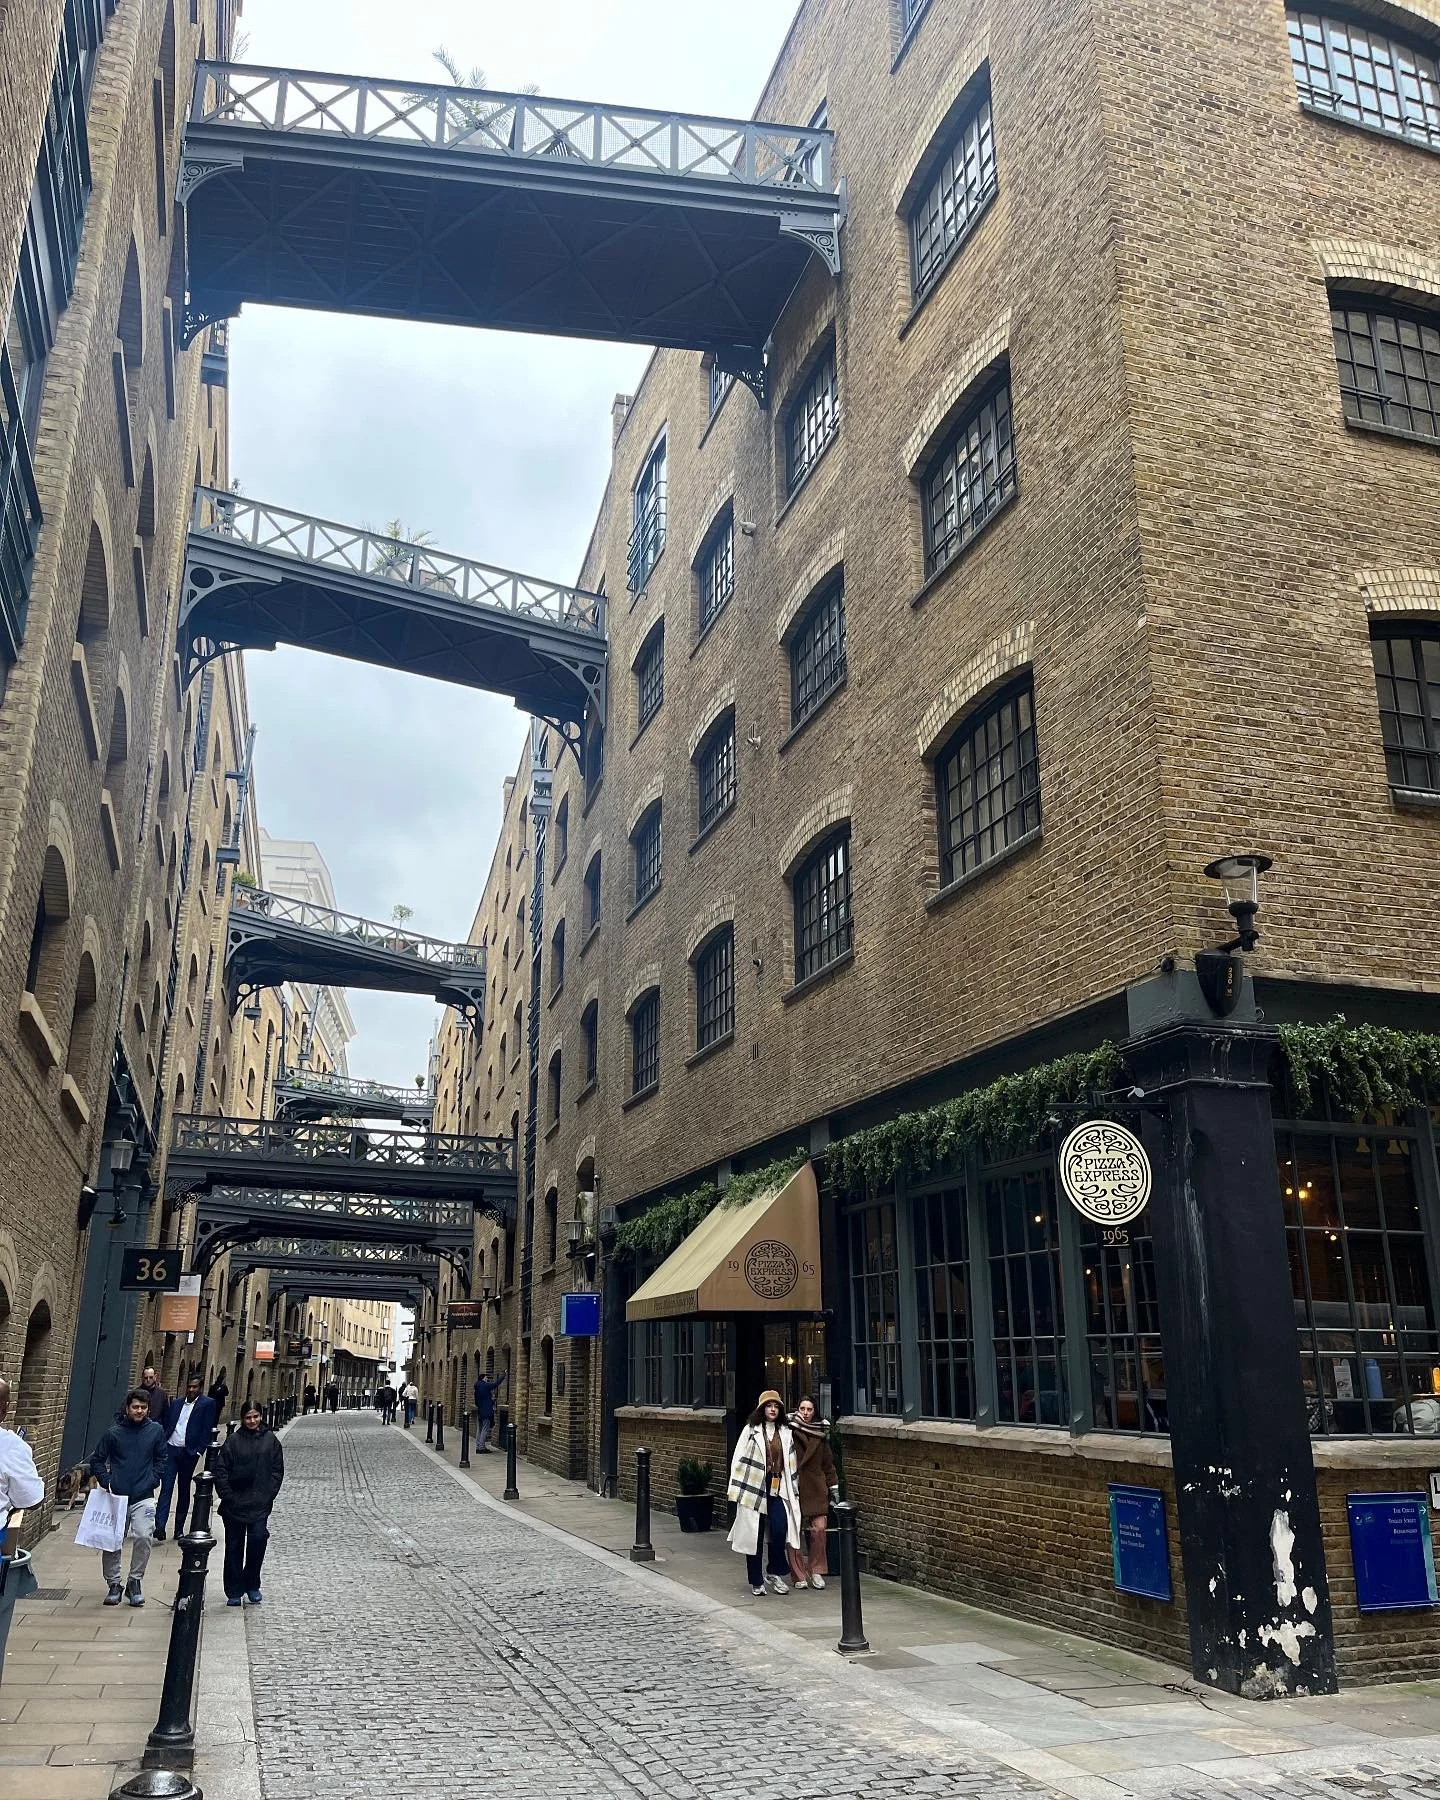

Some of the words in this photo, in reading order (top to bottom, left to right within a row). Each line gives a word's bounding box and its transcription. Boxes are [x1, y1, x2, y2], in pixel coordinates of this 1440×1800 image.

[1084, 1157, 1126, 1170] PIZZA
[1074, 1169, 1140, 1183] EXPRESS
[1102, 1226, 1129, 1244] 1965
[136, 1258, 167, 1281] 36
[728, 1260, 740, 1272] 19
[757, 1260, 785, 1268] PIZZA
[802, 1260, 815, 1276] 65
[750, 1267, 793, 1276] EXPRESS
